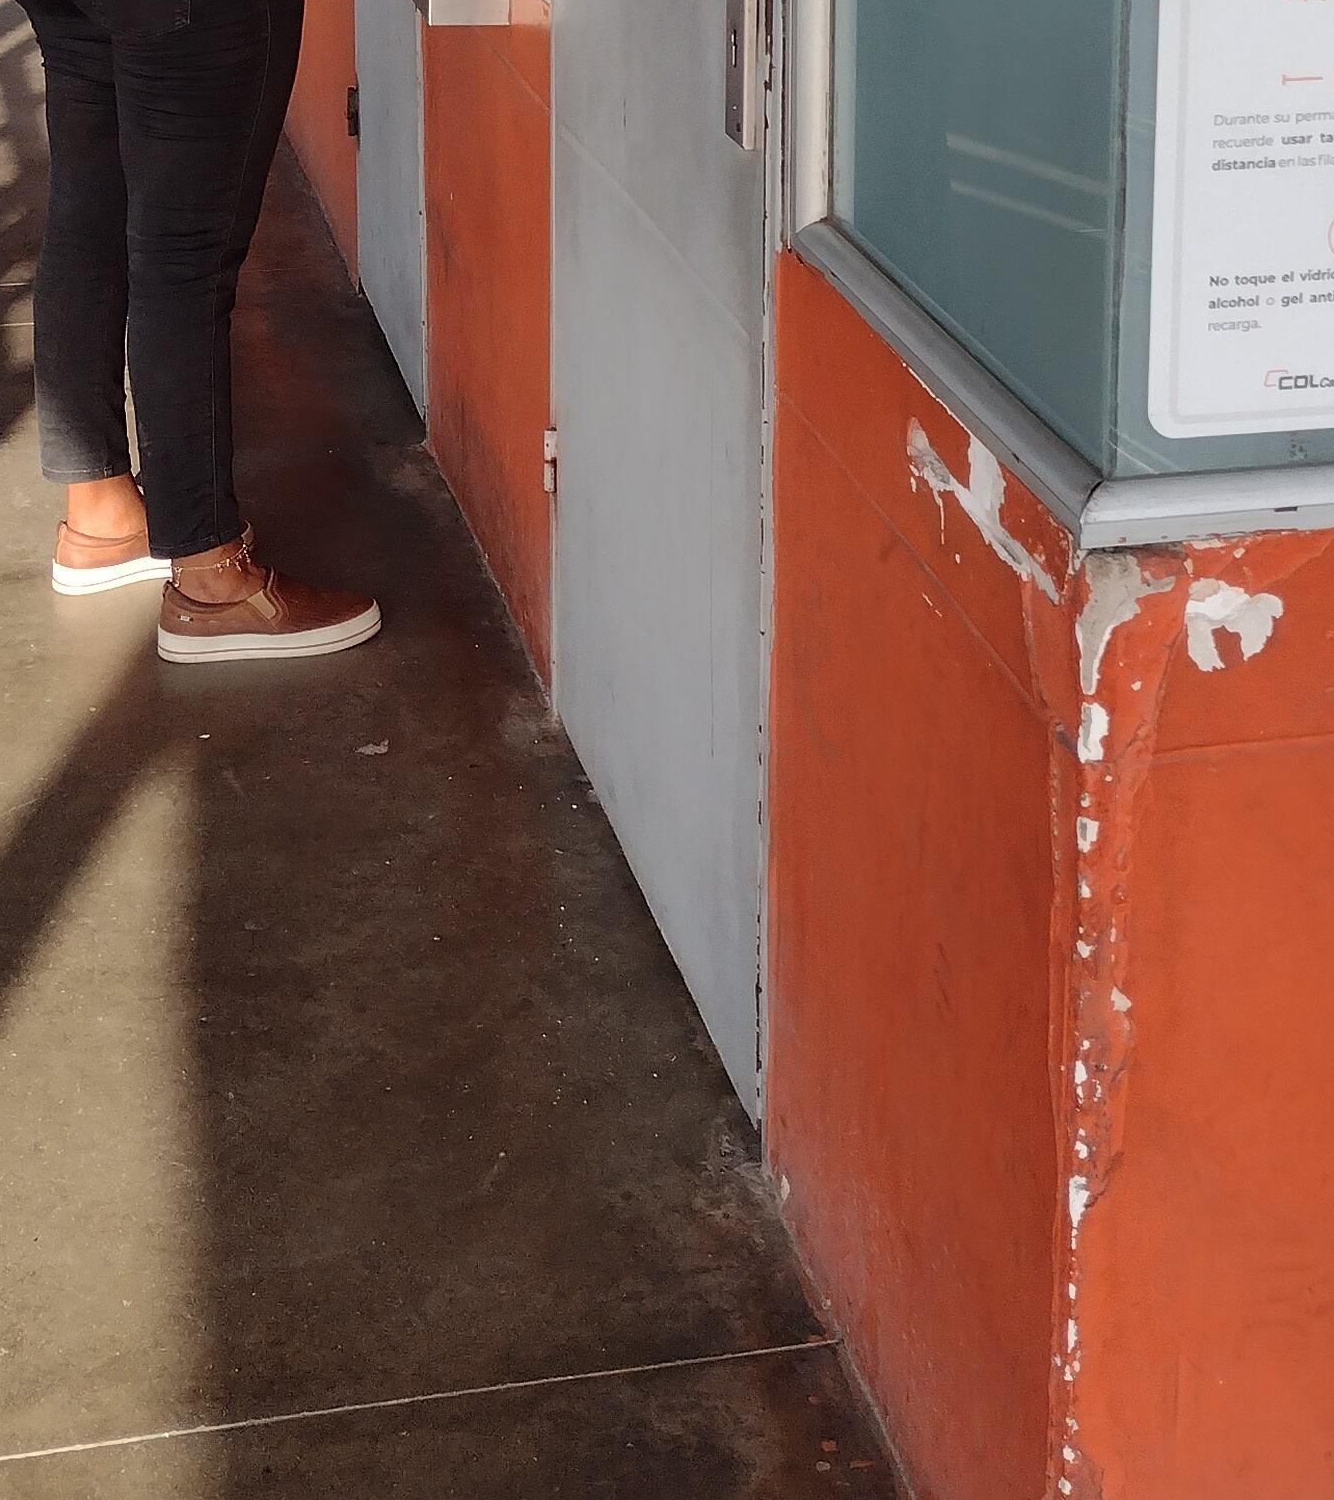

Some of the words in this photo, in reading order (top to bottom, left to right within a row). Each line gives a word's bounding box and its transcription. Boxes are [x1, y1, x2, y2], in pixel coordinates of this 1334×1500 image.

[1213, 114, 1269, 126] Durante
[1274, 114, 1291, 124] su
[1212, 135, 1274, 149] recuerde
[1281, 134, 1313, 145] usar
[1211, 156, 1276, 171] distancia
[1278, 157, 1295, 168] en
[1297, 156, 1316, 167] las
[1209, 275, 1229, 287] No
[1234, 273, 1276, 287] toque
[1281, 271, 1295, 282] el
[1208, 295, 1260, 309] alcohol
[1266, 296, 1275, 306] o
[1281, 292, 1303, 307] gel
[1208, 319, 1262, 332] recarga.
